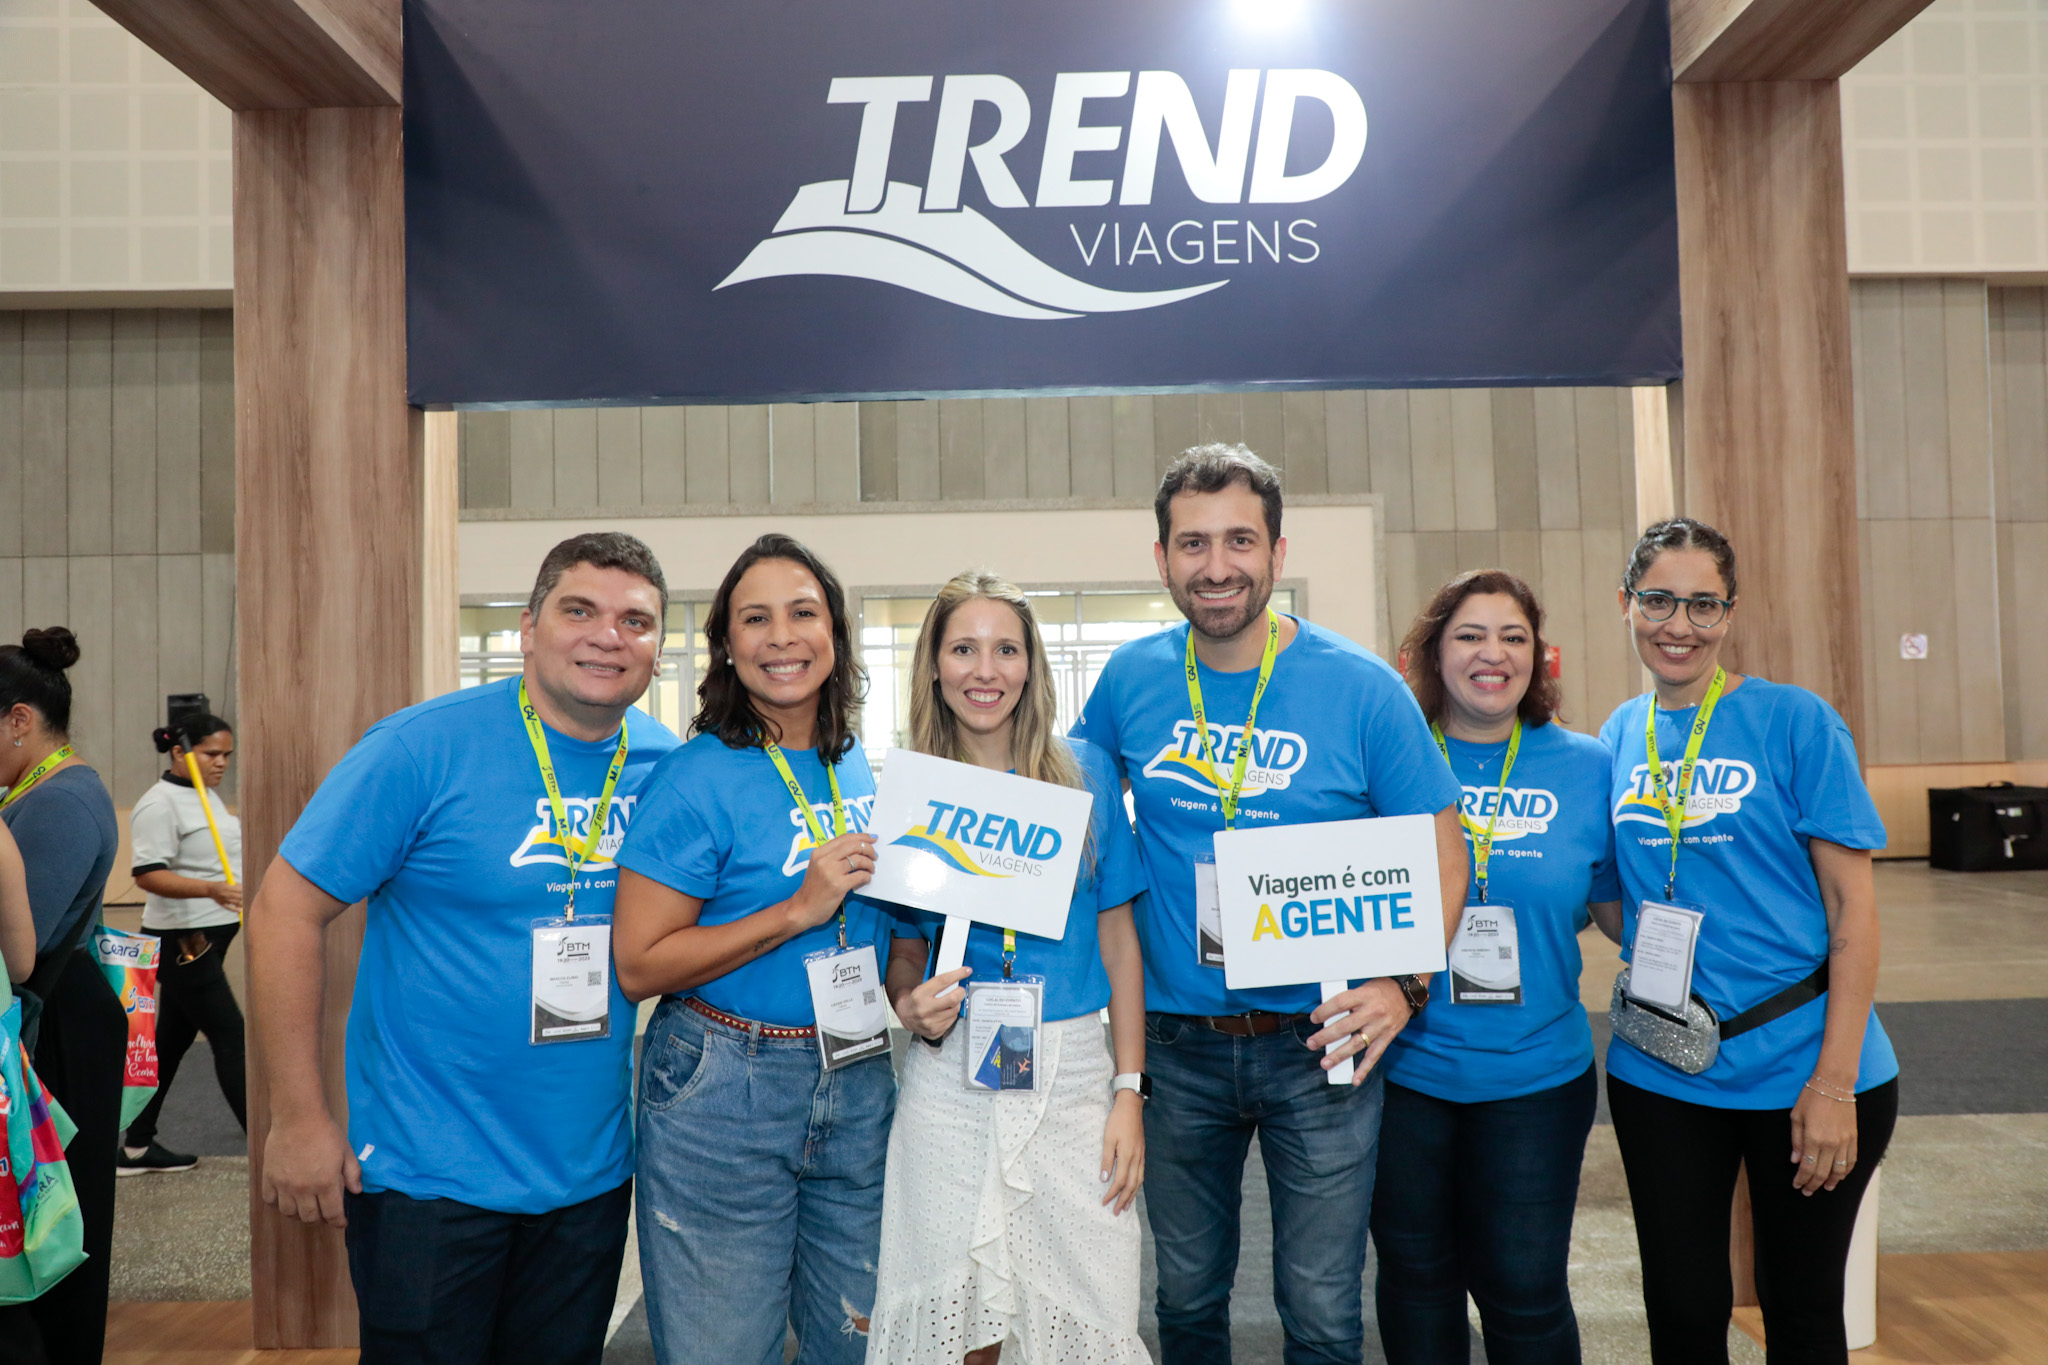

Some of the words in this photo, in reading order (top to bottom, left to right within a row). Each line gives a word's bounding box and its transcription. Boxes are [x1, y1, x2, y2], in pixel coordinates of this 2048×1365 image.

[826, 69, 1368, 214] TREND
[1069, 218, 1321, 266] VIAGENS
[1178, 726, 1301, 770] TREND
[1678, 757, 1695, 806] MANAUS
[1171, 797, 1208, 811] Viagem
[1211, 802, 1218, 812] é
[1245, 808, 1280, 820] agente
[1456, 791, 1553, 818] REND
[1653, 773, 1672, 821] MANAUS
[1688, 797, 1734, 810] IAGENS
[927, 799, 1063, 861] TREND
[1637, 836, 1673, 847] Viagem
[1683, 836, 1700, 844] com
[979, 851, 1043, 877] VIAGENS
[1508, 848, 1543, 859] agente
[546, 880, 581, 894] Viagem
[584, 878, 591, 889] é
[594, 880, 616, 889] com
[1248, 874, 1337, 898] Viagem
[1342, 865, 1356, 888] é
[1361, 867, 1410, 887] com
[1252, 891, 1414, 942] AGENTE
[1475, 920, 1498, 928] BTM
[99, 938, 141, 958] Ceará
[567, 942, 591, 952] BTM
[839, 964, 861, 977] BTM
